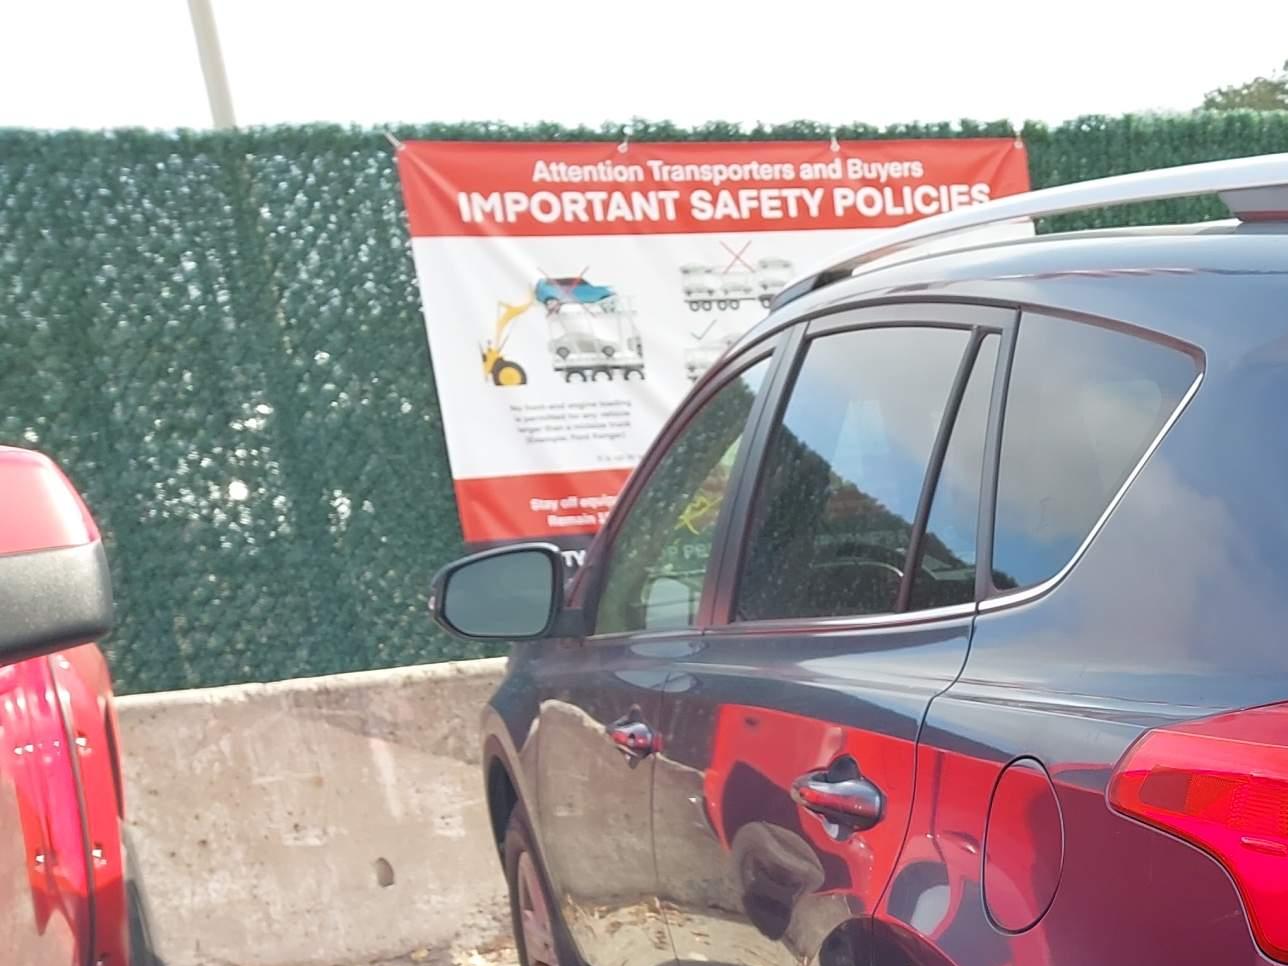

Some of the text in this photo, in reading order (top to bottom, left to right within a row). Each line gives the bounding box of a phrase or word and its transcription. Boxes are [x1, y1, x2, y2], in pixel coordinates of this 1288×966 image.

[532, 158, 924, 186] Attention Transporters and Buyers
[457, 183, 992, 224] IMPORTANT SAFETY POLICIES
